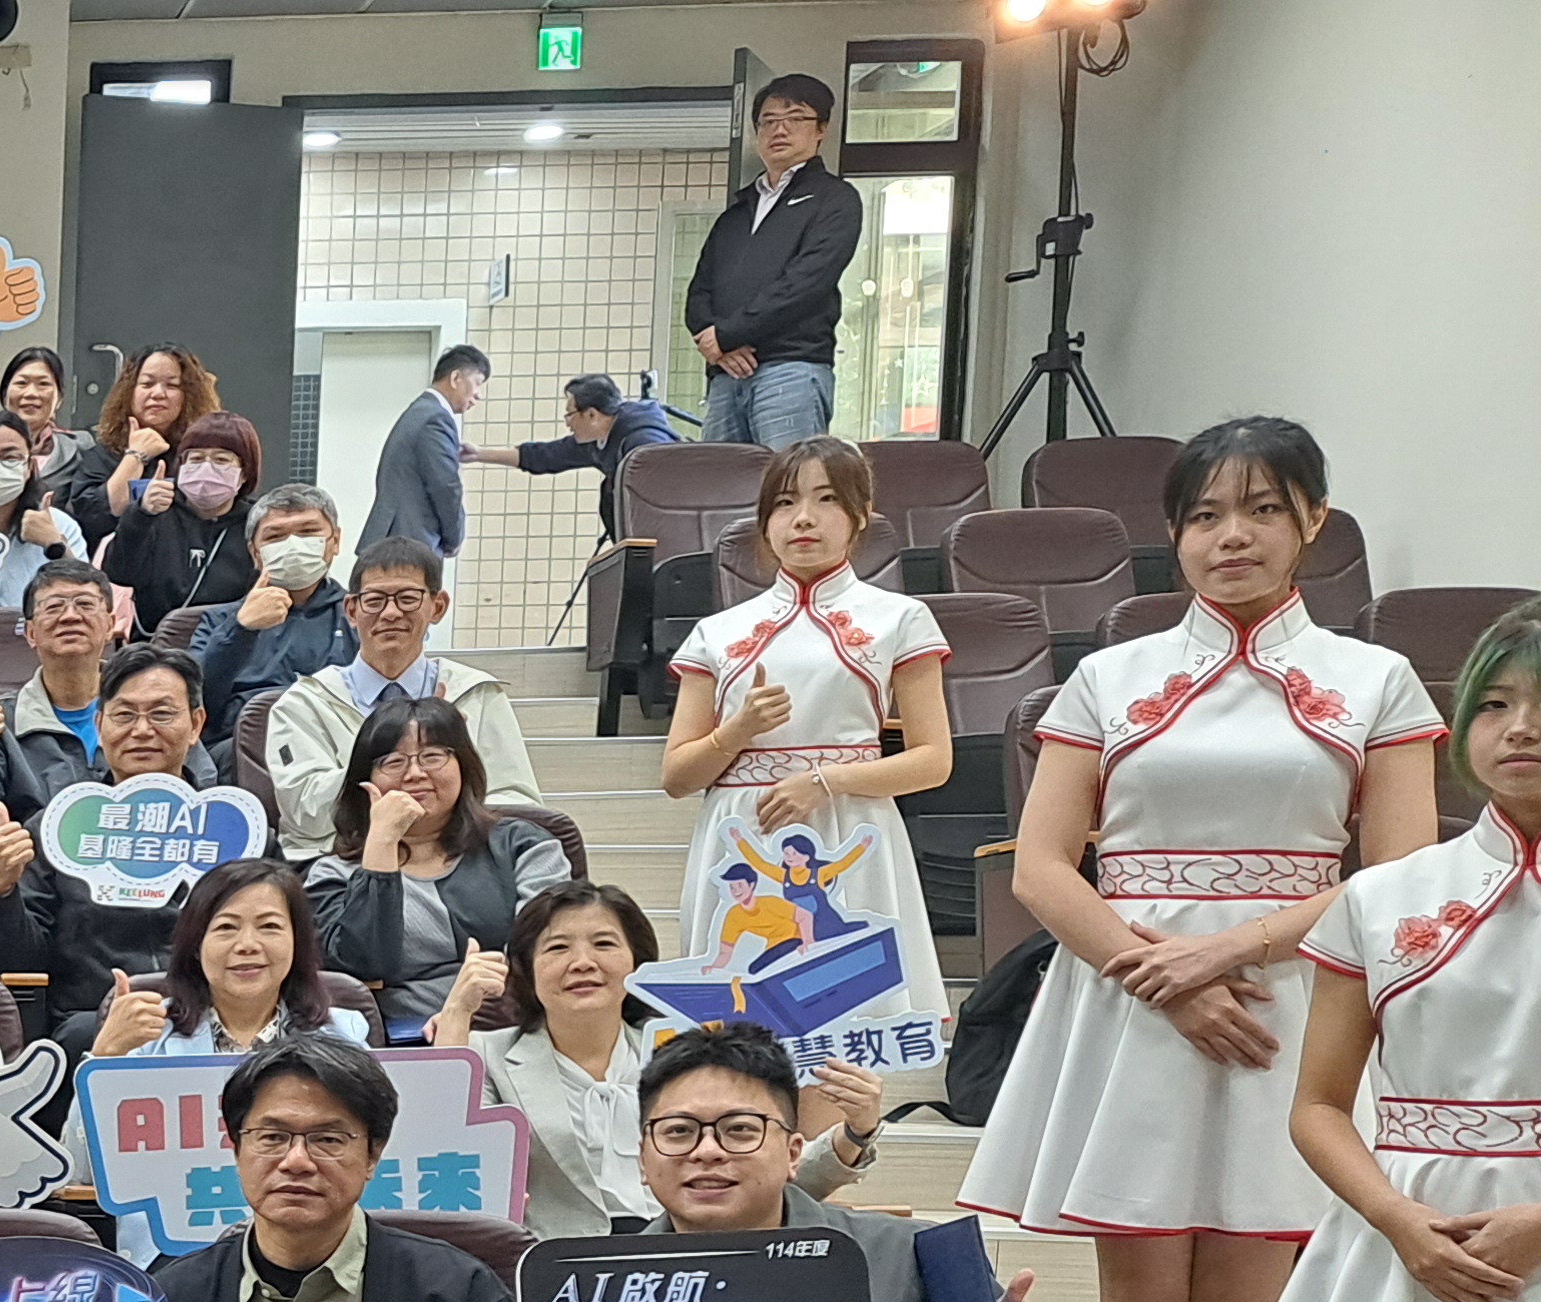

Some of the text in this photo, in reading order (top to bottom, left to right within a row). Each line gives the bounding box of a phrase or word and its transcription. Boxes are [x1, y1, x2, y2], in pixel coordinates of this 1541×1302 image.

[77, 833, 220, 864] 基隆全都有
[119, 887, 165, 899] KEELUNG
[766, 1240, 831, 1259] 114年度
